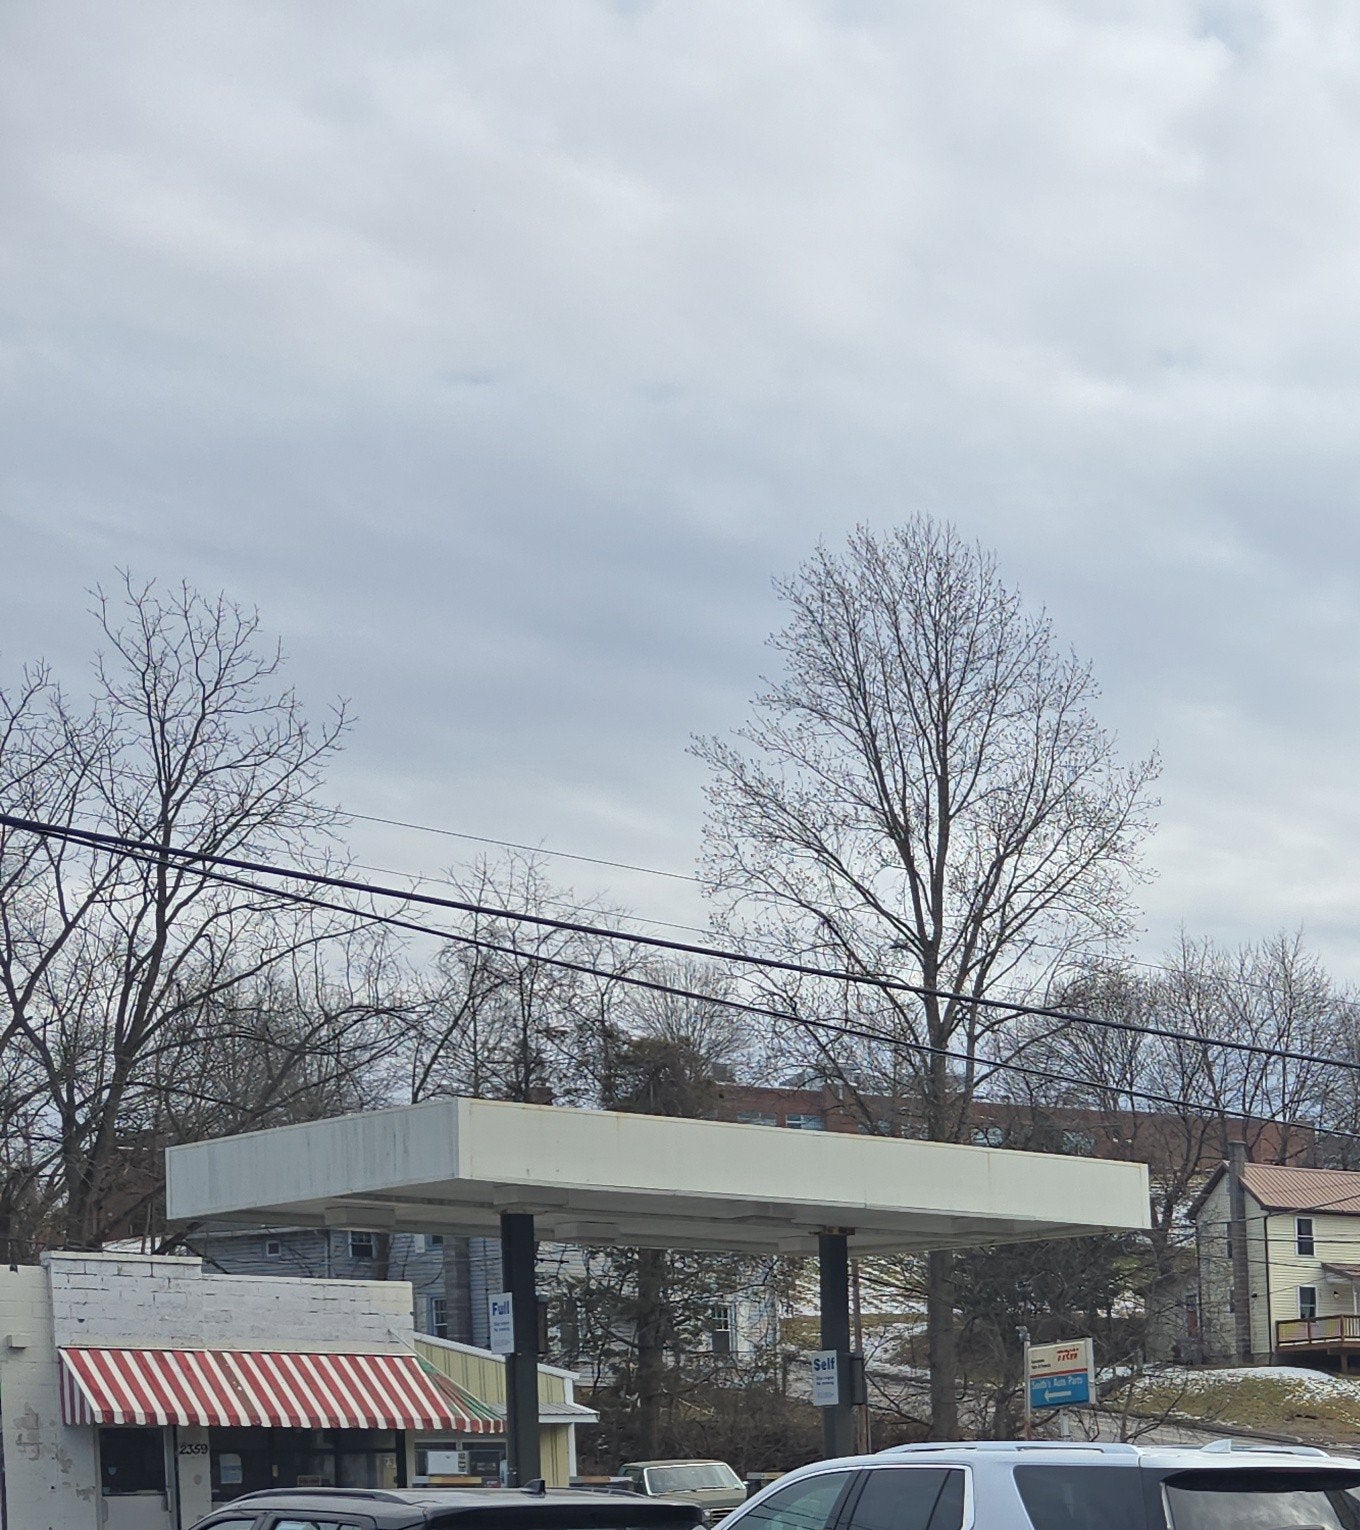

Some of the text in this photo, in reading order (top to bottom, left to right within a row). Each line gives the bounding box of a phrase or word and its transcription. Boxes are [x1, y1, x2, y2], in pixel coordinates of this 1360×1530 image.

[492, 1300, 510, 1317] Full
[813, 1357, 836, 1372] Self
[179, 1444, 208, 1455] 2359
